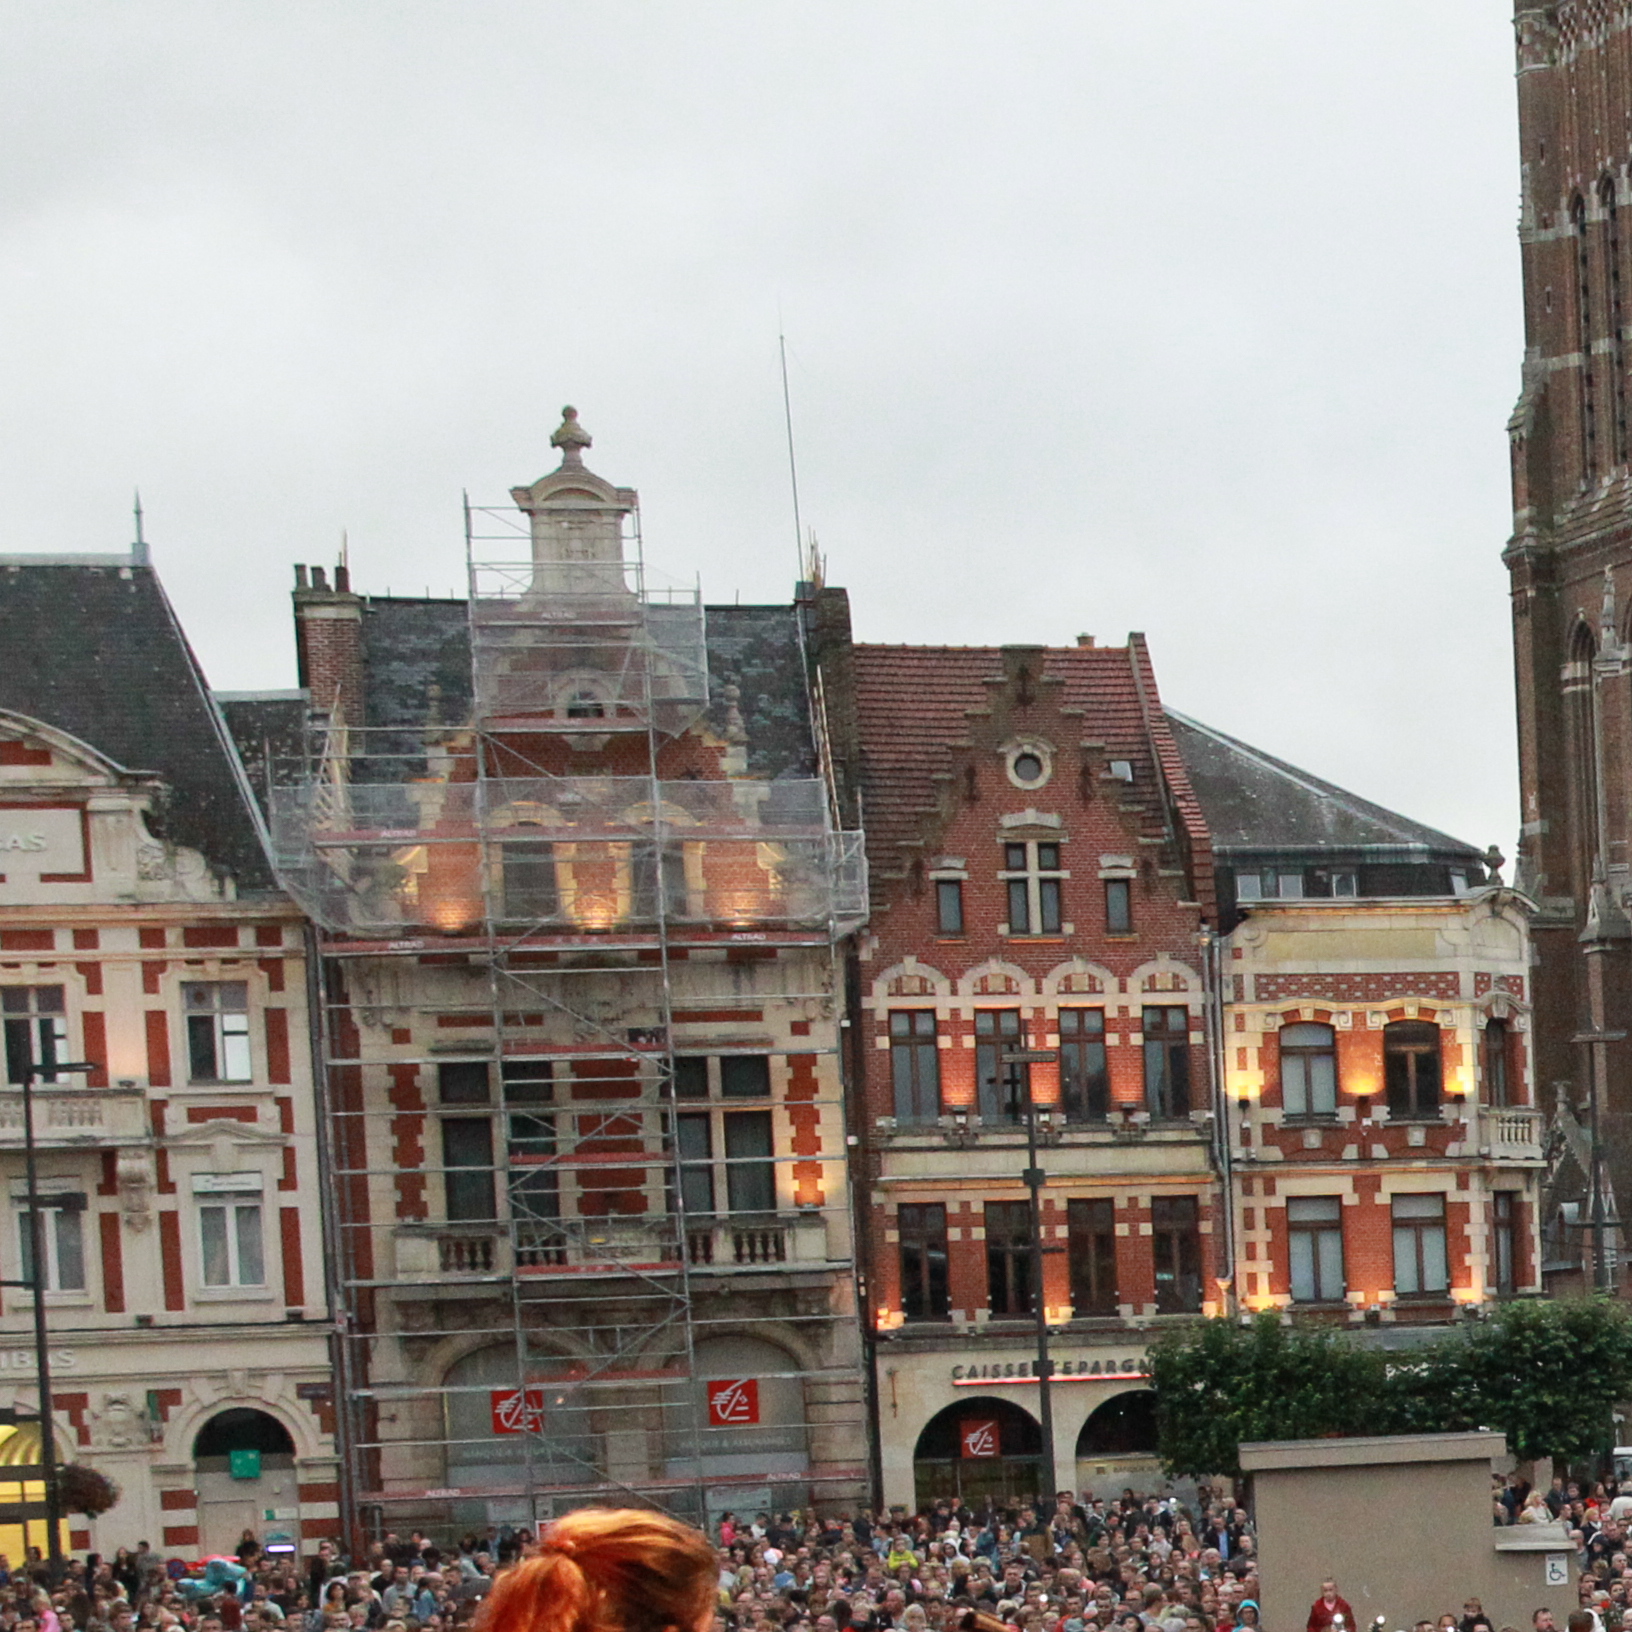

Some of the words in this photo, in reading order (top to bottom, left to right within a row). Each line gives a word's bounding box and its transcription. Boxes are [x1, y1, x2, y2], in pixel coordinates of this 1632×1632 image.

[0, 833, 46, 852] AS
[952, 1361, 1027, 1380] CAISSE
[1053, 1357, 1155, 1377] 'EPARGN
